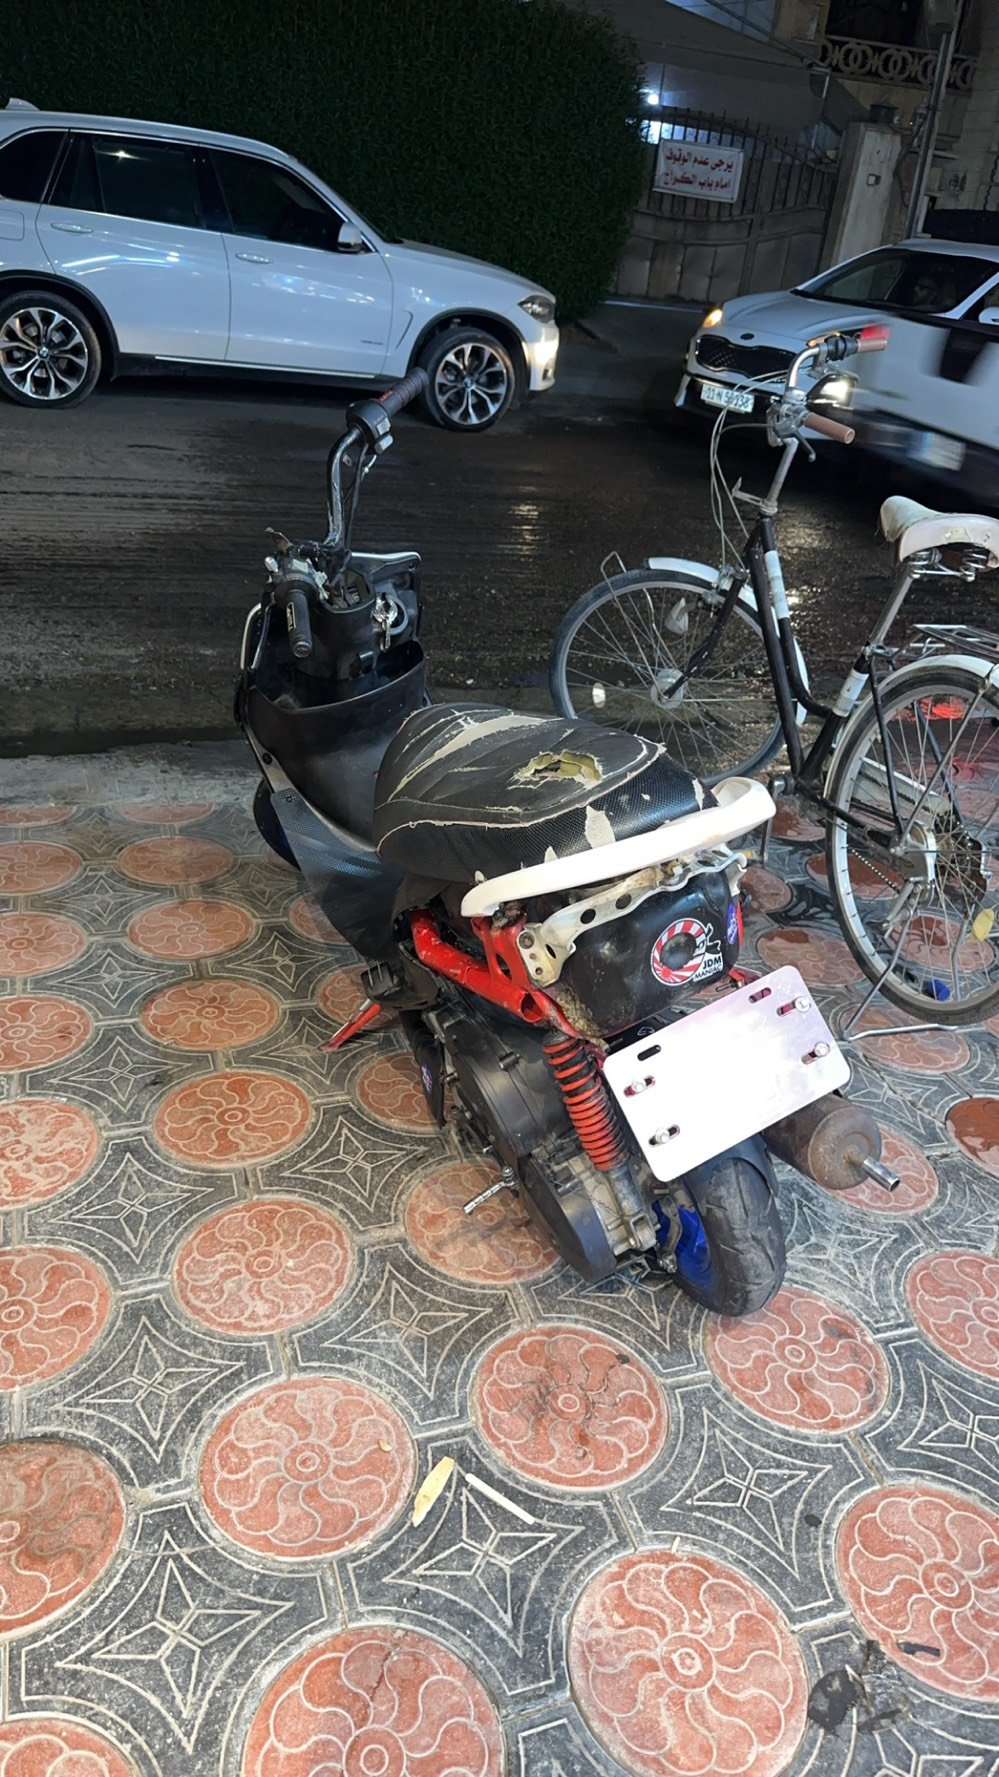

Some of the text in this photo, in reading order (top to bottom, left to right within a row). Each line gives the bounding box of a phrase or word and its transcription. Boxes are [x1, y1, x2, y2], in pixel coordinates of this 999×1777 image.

[665, 148, 734, 173] يرجى عدم الوقوف
[663, 170, 697, 186] الكراج
[698, 175, 713, 190] باب
[703, 955, 722, 970] JDM
[694, 964, 722, 980] MANIAC
